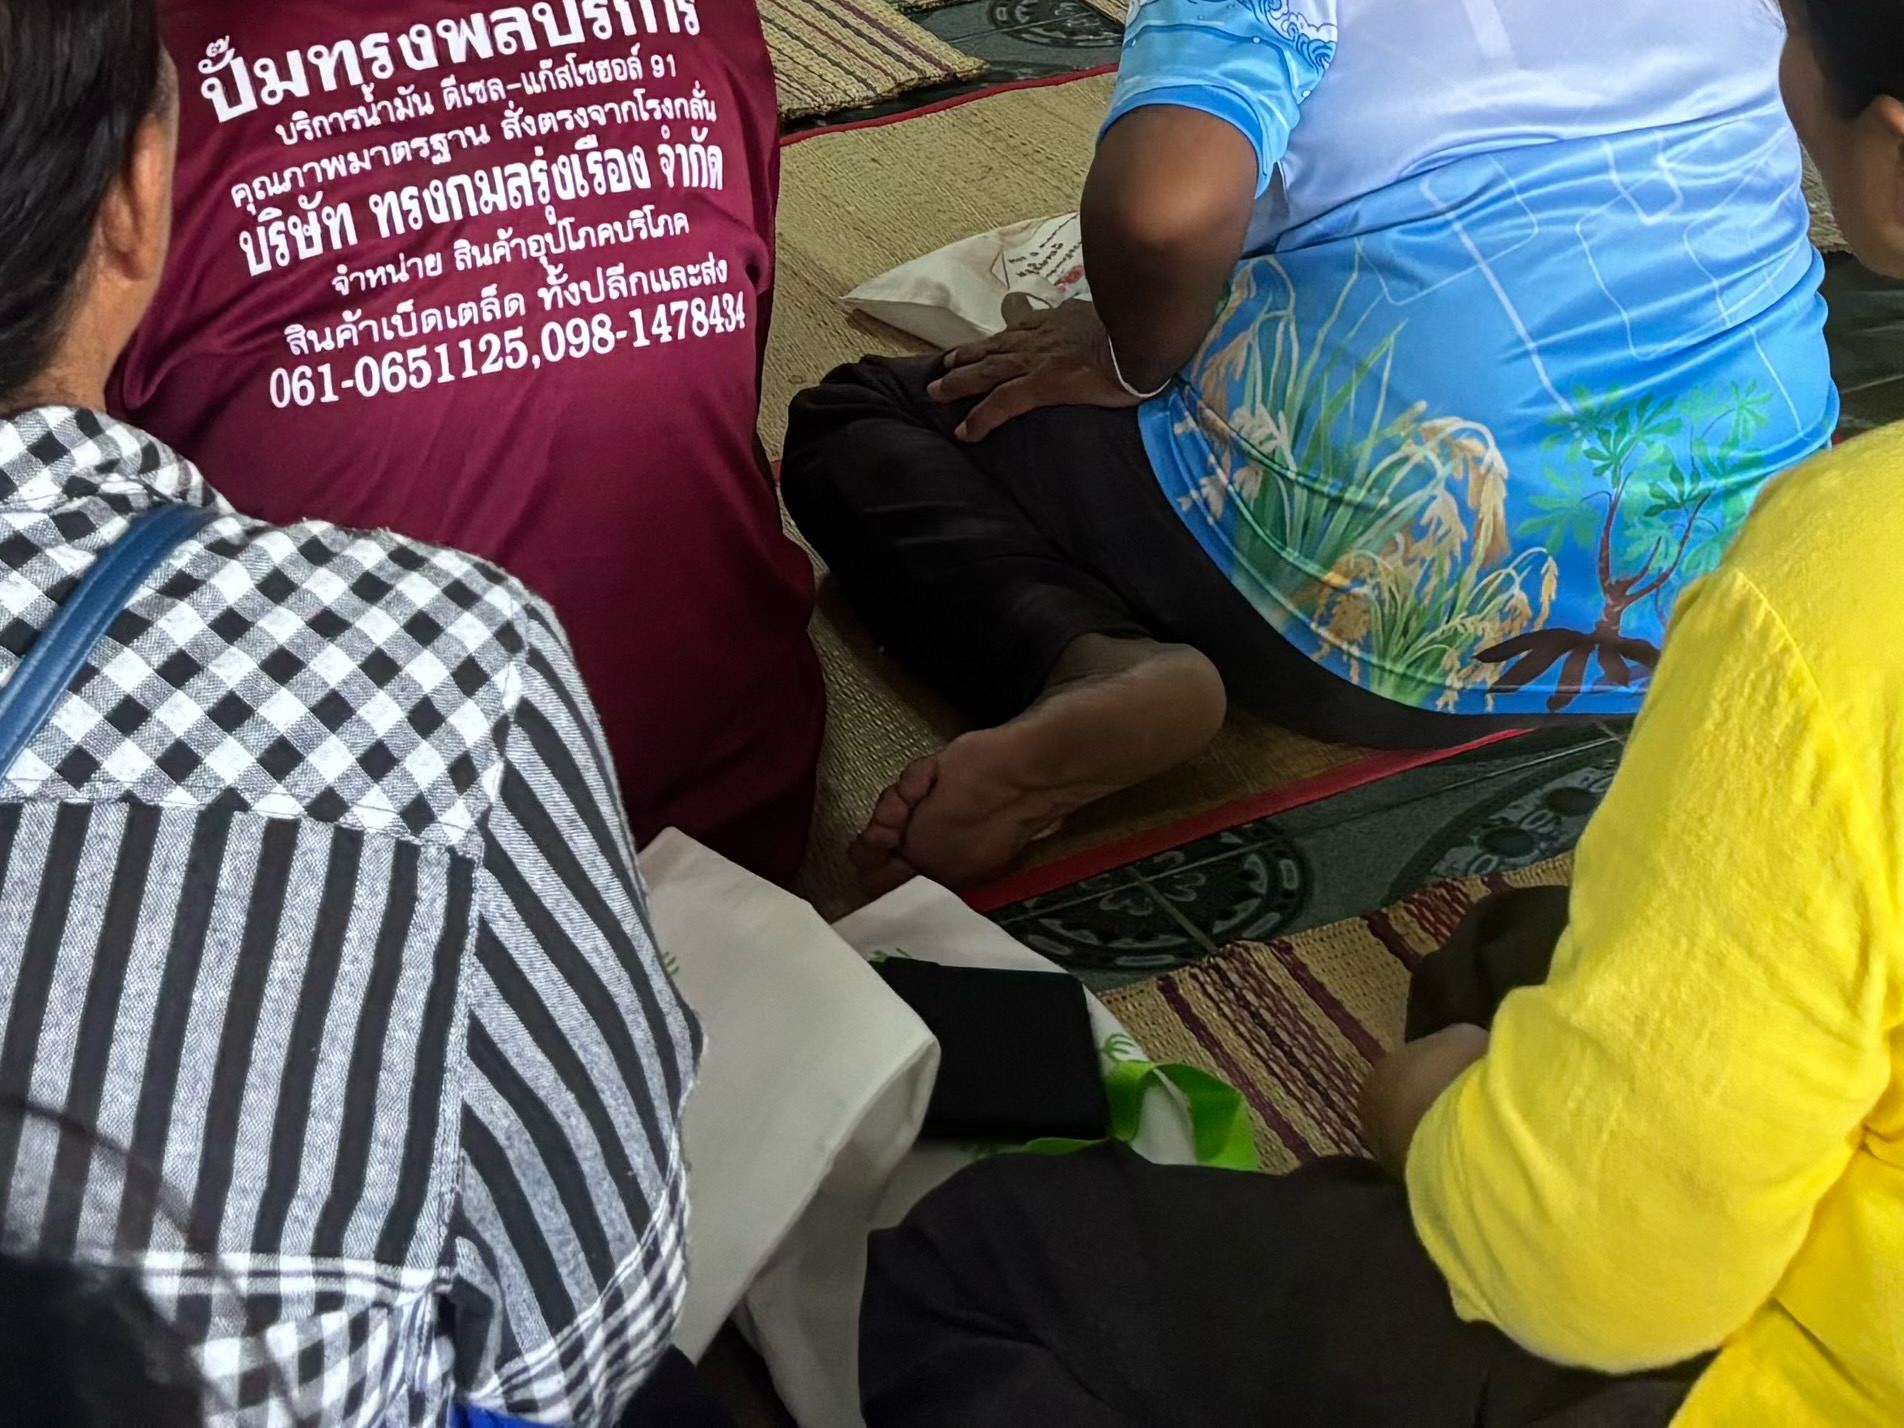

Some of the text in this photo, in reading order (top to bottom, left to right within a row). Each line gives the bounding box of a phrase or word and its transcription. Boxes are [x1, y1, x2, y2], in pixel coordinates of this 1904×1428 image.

[231, 80, 717, 210] คุณภาพมาตรฐาน สั่งตรงจากโรงกลั่น
[276, 83, 433, 147] บริการน้ำมัน
[651, 53, 677, 78] 91
[239, 125, 724, 277] บริษัท ทรงกมลรุ่งเรือง จำกัด
[331, 204, 690, 298] จำหน่าย สินค้าอุปโภคบริโภค
[284, 251, 728, 356] สินค้าเบ็ดเตล็ด ทั้งปลีกและส่ง
